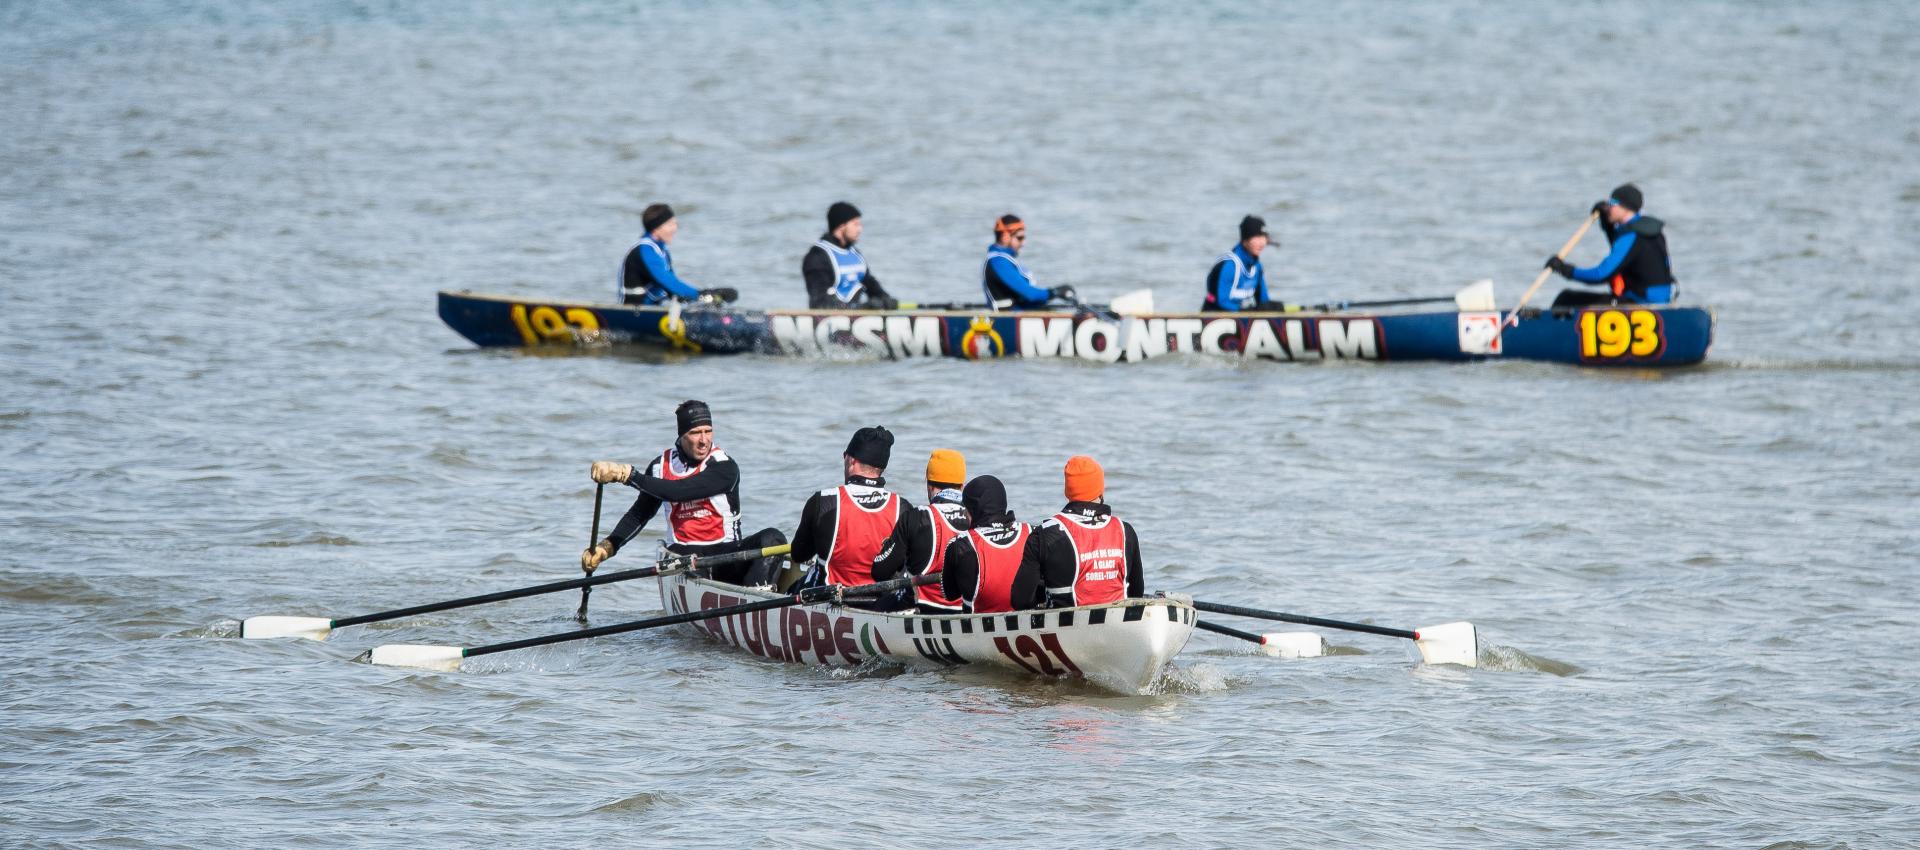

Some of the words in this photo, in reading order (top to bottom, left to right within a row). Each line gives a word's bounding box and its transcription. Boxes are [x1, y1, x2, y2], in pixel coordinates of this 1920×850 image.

[772, 316, 942, 359] NCSM
[1020, 318, 1378, 361] MONTCALM
[1579, 310, 1660, 358] 193
[993, 633, 1084, 677] 121
